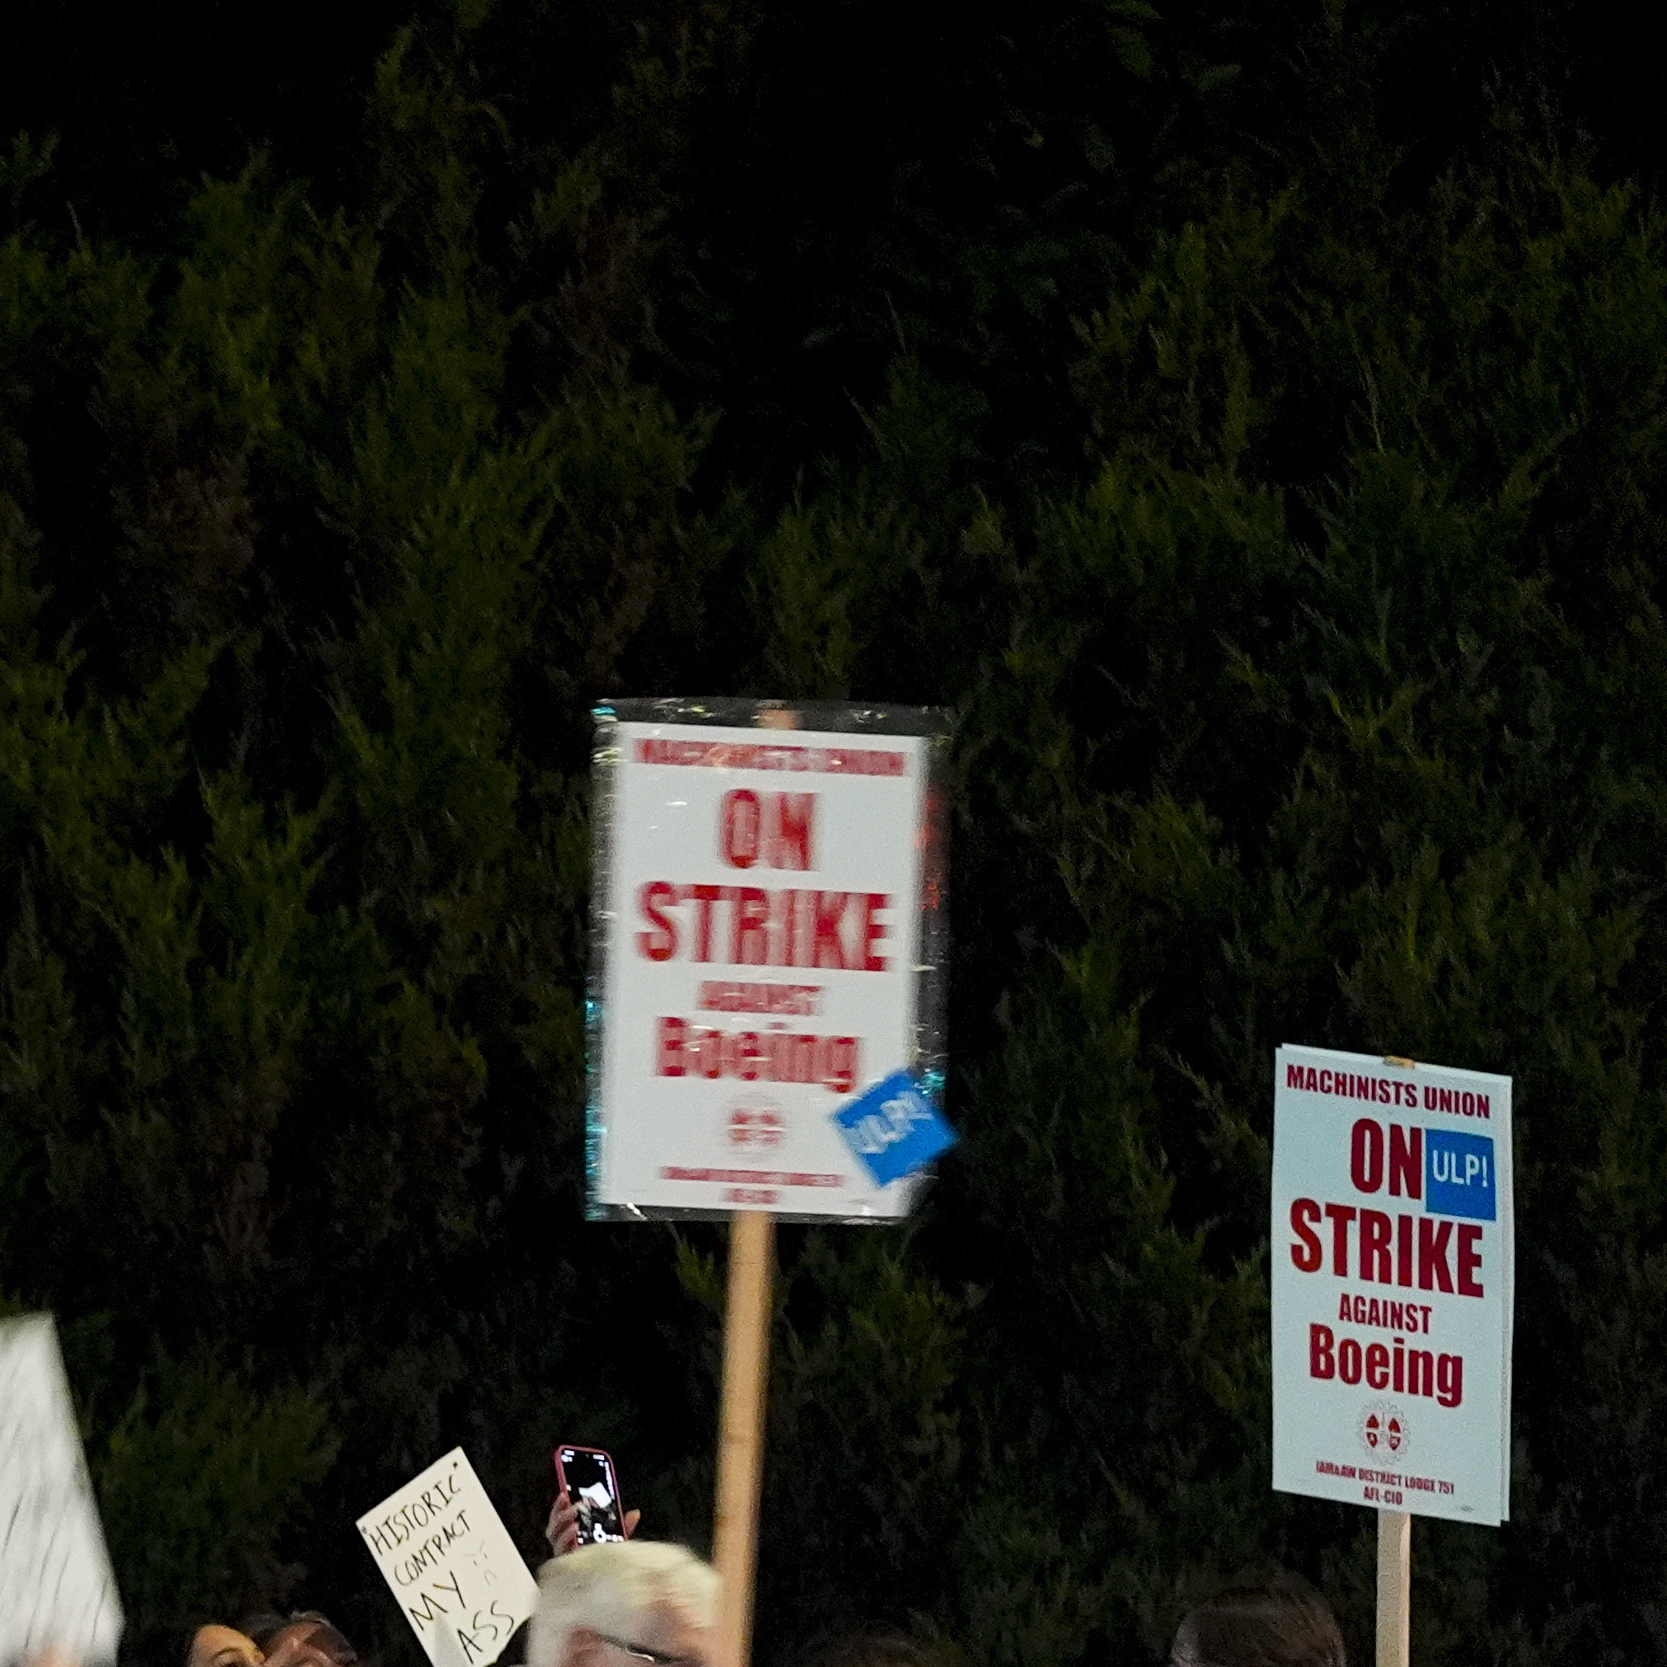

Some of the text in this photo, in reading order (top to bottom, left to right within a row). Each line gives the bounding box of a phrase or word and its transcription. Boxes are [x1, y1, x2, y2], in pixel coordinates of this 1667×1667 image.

[717, 788, 818, 871] ON
[635, 879, 896, 973] STRIKE
[1286, 1063, 1491, 1119] MACHINISTS UNION
[1350, 1116, 1423, 1201] ON
[1432, 1148, 1490, 1189] ULP!
[1289, 1197, 1485, 1298] STRIKE
[1338, 1292, 1433, 1336] AGAINST
[1308, 1322, 1464, 1408] Boeing
[1358, 1467, 1402, 1487] DISTRICT
[394, 1508, 471, 1587] CONTRACT
[409, 1570, 466, 1632] MY
[457, 1600, 515, 1665] ASS
